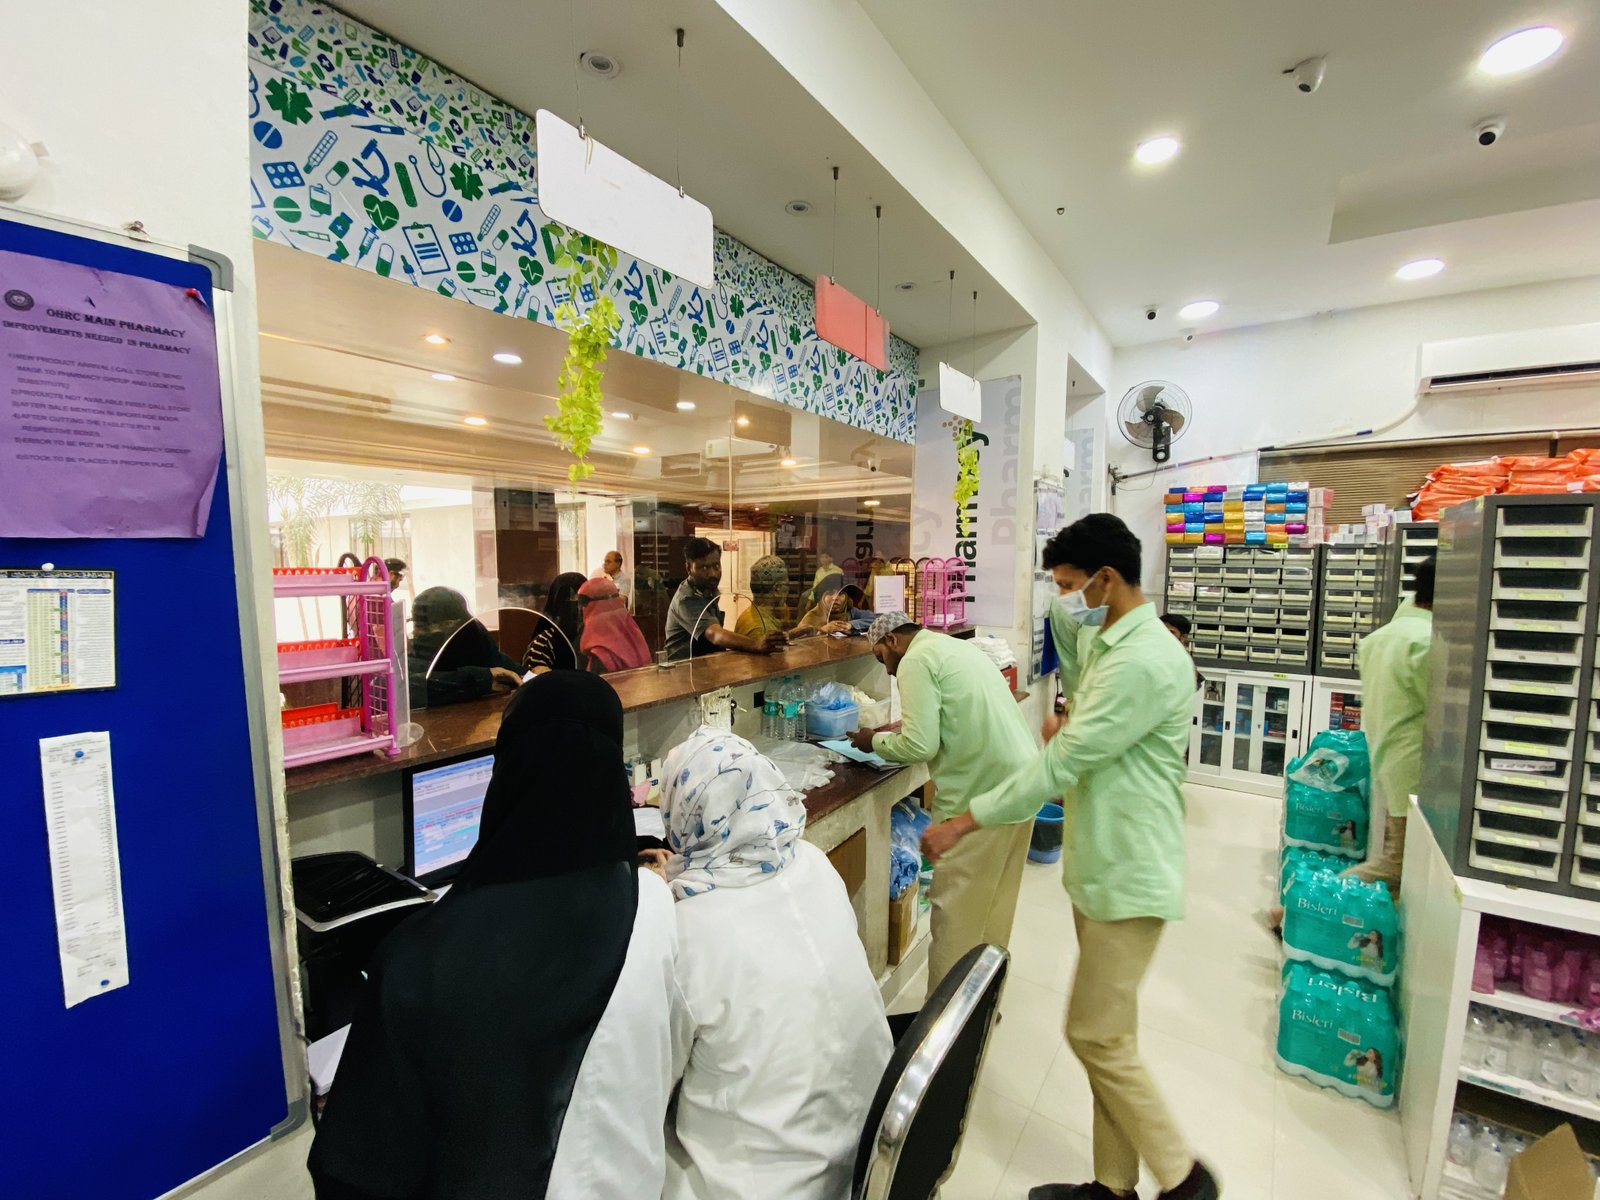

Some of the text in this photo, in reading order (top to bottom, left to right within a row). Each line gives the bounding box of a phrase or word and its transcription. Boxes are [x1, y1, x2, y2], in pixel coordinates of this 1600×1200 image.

[46, 308, 186, 338] OHRC MAIN PHARMACY
[2, 320, 191, 355] IMPROVEMENTS NEEDED IN PHARMACY
[57, 370, 100, 381] PHARMACY
[148, 382, 168, 390] LOOK
[84, 396, 122, 405] AVAILABLE
[70, 406, 104, 414] MENTION
[48, 415, 84, 424] CUTTING
[22, 425, 71, 434] RESPECTIVE
[121, 444, 162, 452] PHARMACY
[1298, 897, 1337, 916] Bisleri
[1292, 1009, 1334, 1029] Bisleri
